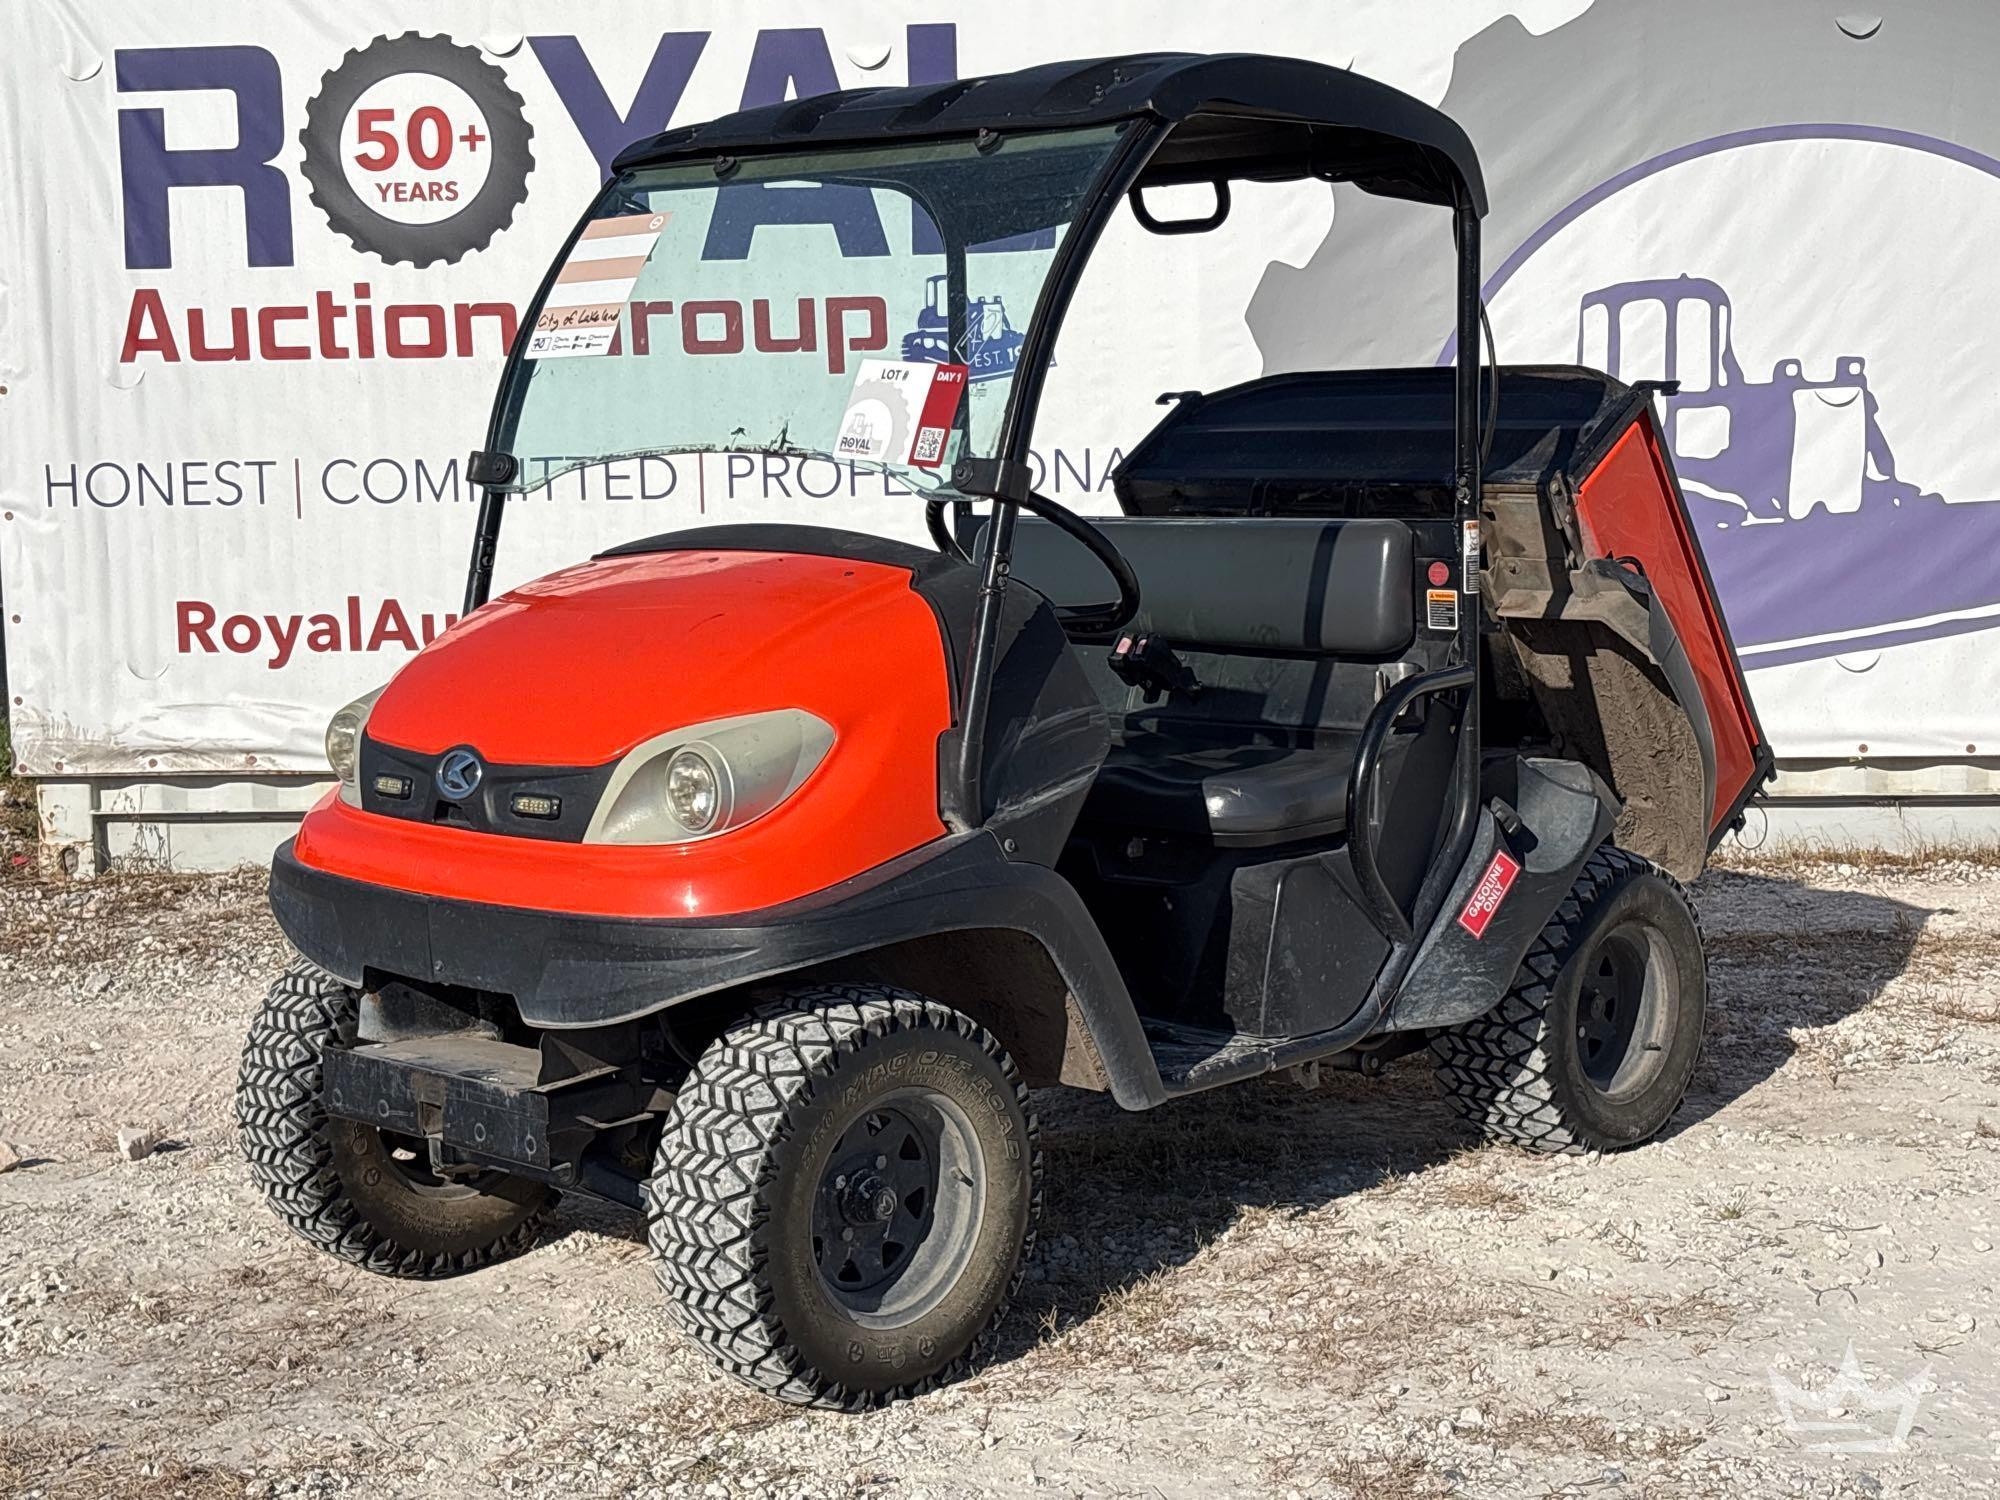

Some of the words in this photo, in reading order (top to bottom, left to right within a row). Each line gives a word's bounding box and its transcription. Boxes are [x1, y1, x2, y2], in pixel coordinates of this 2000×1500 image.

[354, 105, 486, 171] 50+
[374, 181, 459, 202] YEARS
[120, 282, 517, 363] Auction
[607, 296, 886, 374] roup
[538, 312, 559, 332] City
[563, 310, 578, 326] of
[974, 351, 1003, 367] EST.
[881, 369, 902, 380] LOT
[937, 371, 956, 382] DAY
[956, 373, 962, 383] 1
[840, 437, 870, 450] ROYAL
[45, 460, 277, 508] HONEST
[321, 456, 677, 505] COMITTED
[1469, 863, 1504, 917] GASOLINE
[1483, 881, 1503, 912] ONLY
[842, 1051, 909, 1107] MAG
[918, 1051, 974, 1074] OFF
[973, 1077, 1021, 1161] ROAD
